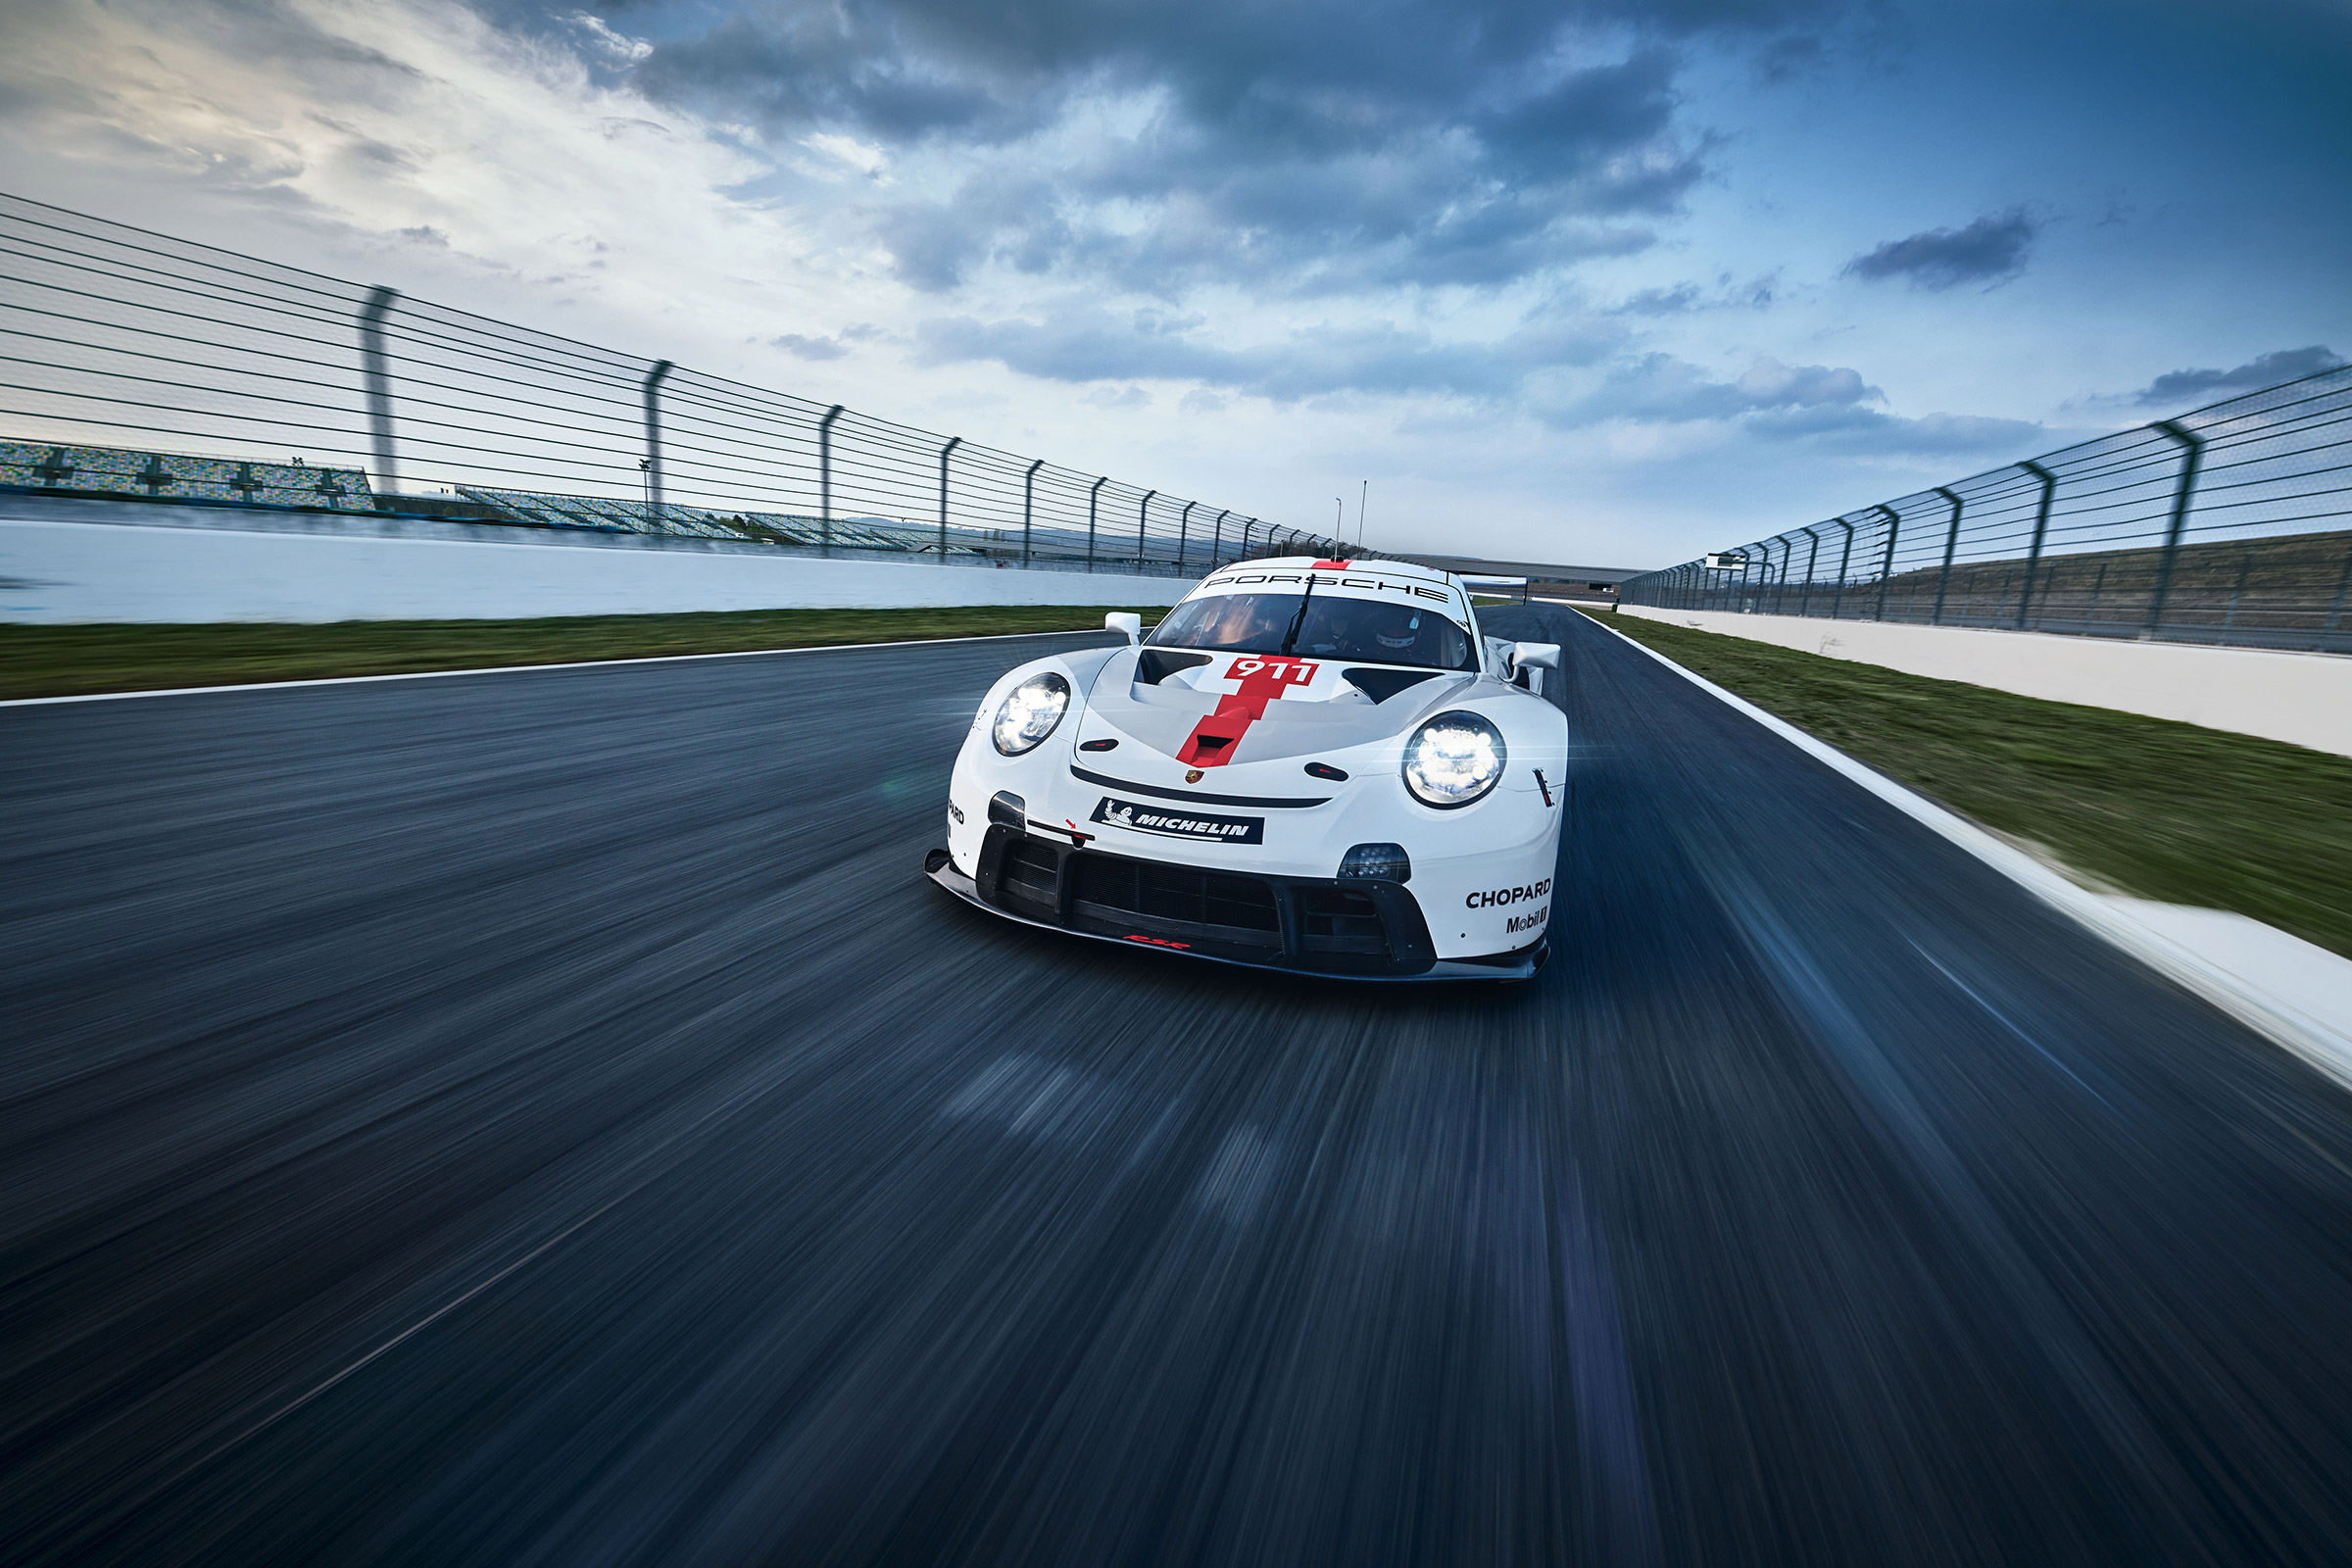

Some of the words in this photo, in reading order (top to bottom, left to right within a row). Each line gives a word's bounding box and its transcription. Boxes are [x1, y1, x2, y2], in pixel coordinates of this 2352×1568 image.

[1204, 574, 1449, 604] PORSCHE
[1237, 661, 1311, 682] 911
[1135, 813, 1250, 836] MICHELIN
[1465, 878, 1551, 908] CHOPARD
[1122, 934, 1192, 950] RSR
